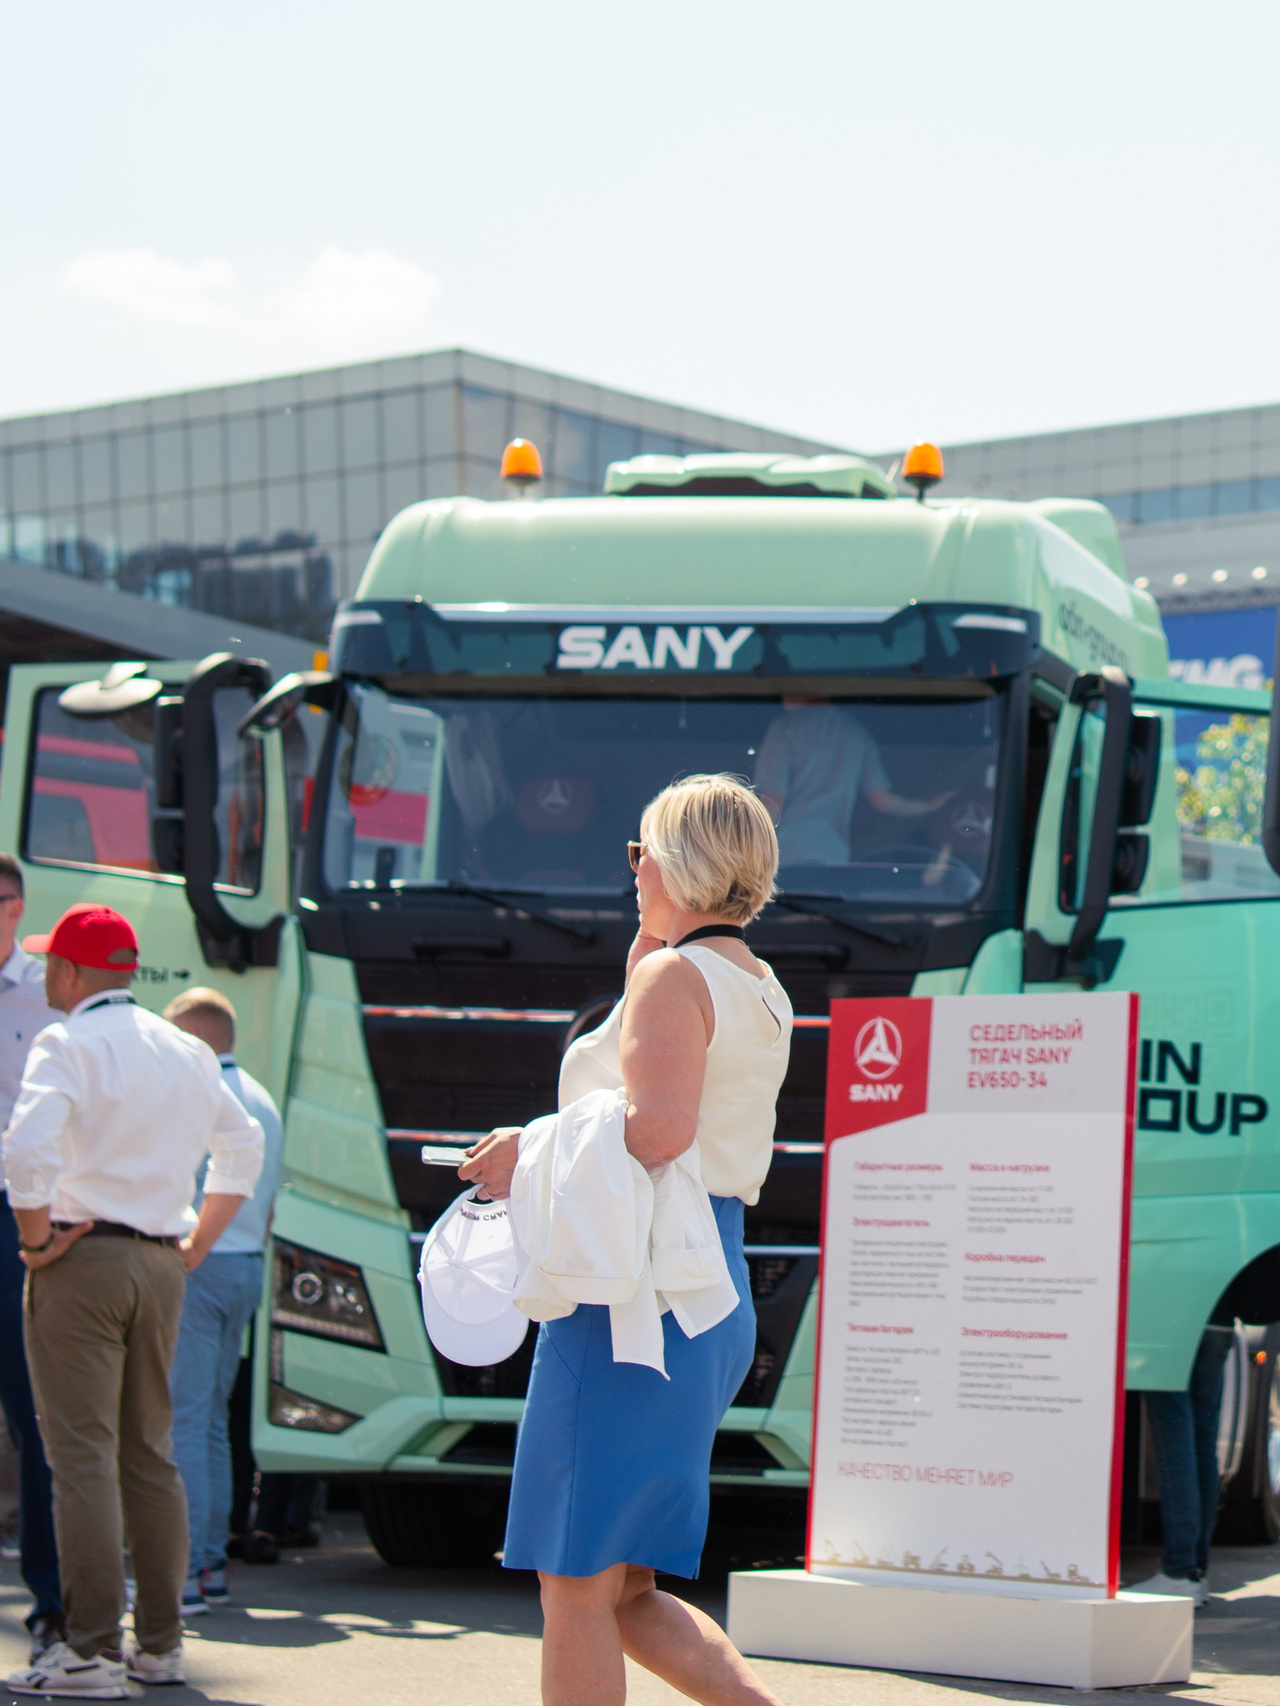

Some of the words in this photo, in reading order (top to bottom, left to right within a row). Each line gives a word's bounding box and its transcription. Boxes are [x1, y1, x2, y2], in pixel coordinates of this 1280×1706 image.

[556, 626, 755, 669] SANY
[969, 1018, 1083, 1041] СЕДЕЛЬНЫЙ
[968, 1047, 1022, 1064] ТЯГАЧ
[1025, 1046, 1072, 1065] SANY
[1140, 1038, 1202, 1085] IN
[967, 1071, 1048, 1088] EV650-34
[849, 1083, 904, 1102] SANY
[838, 1461, 913, 1482] КАЧЕСТВО
[914, 1465, 976, 1487] МЕНЯЕТ
[978, 1469, 1014, 1489] МИР
